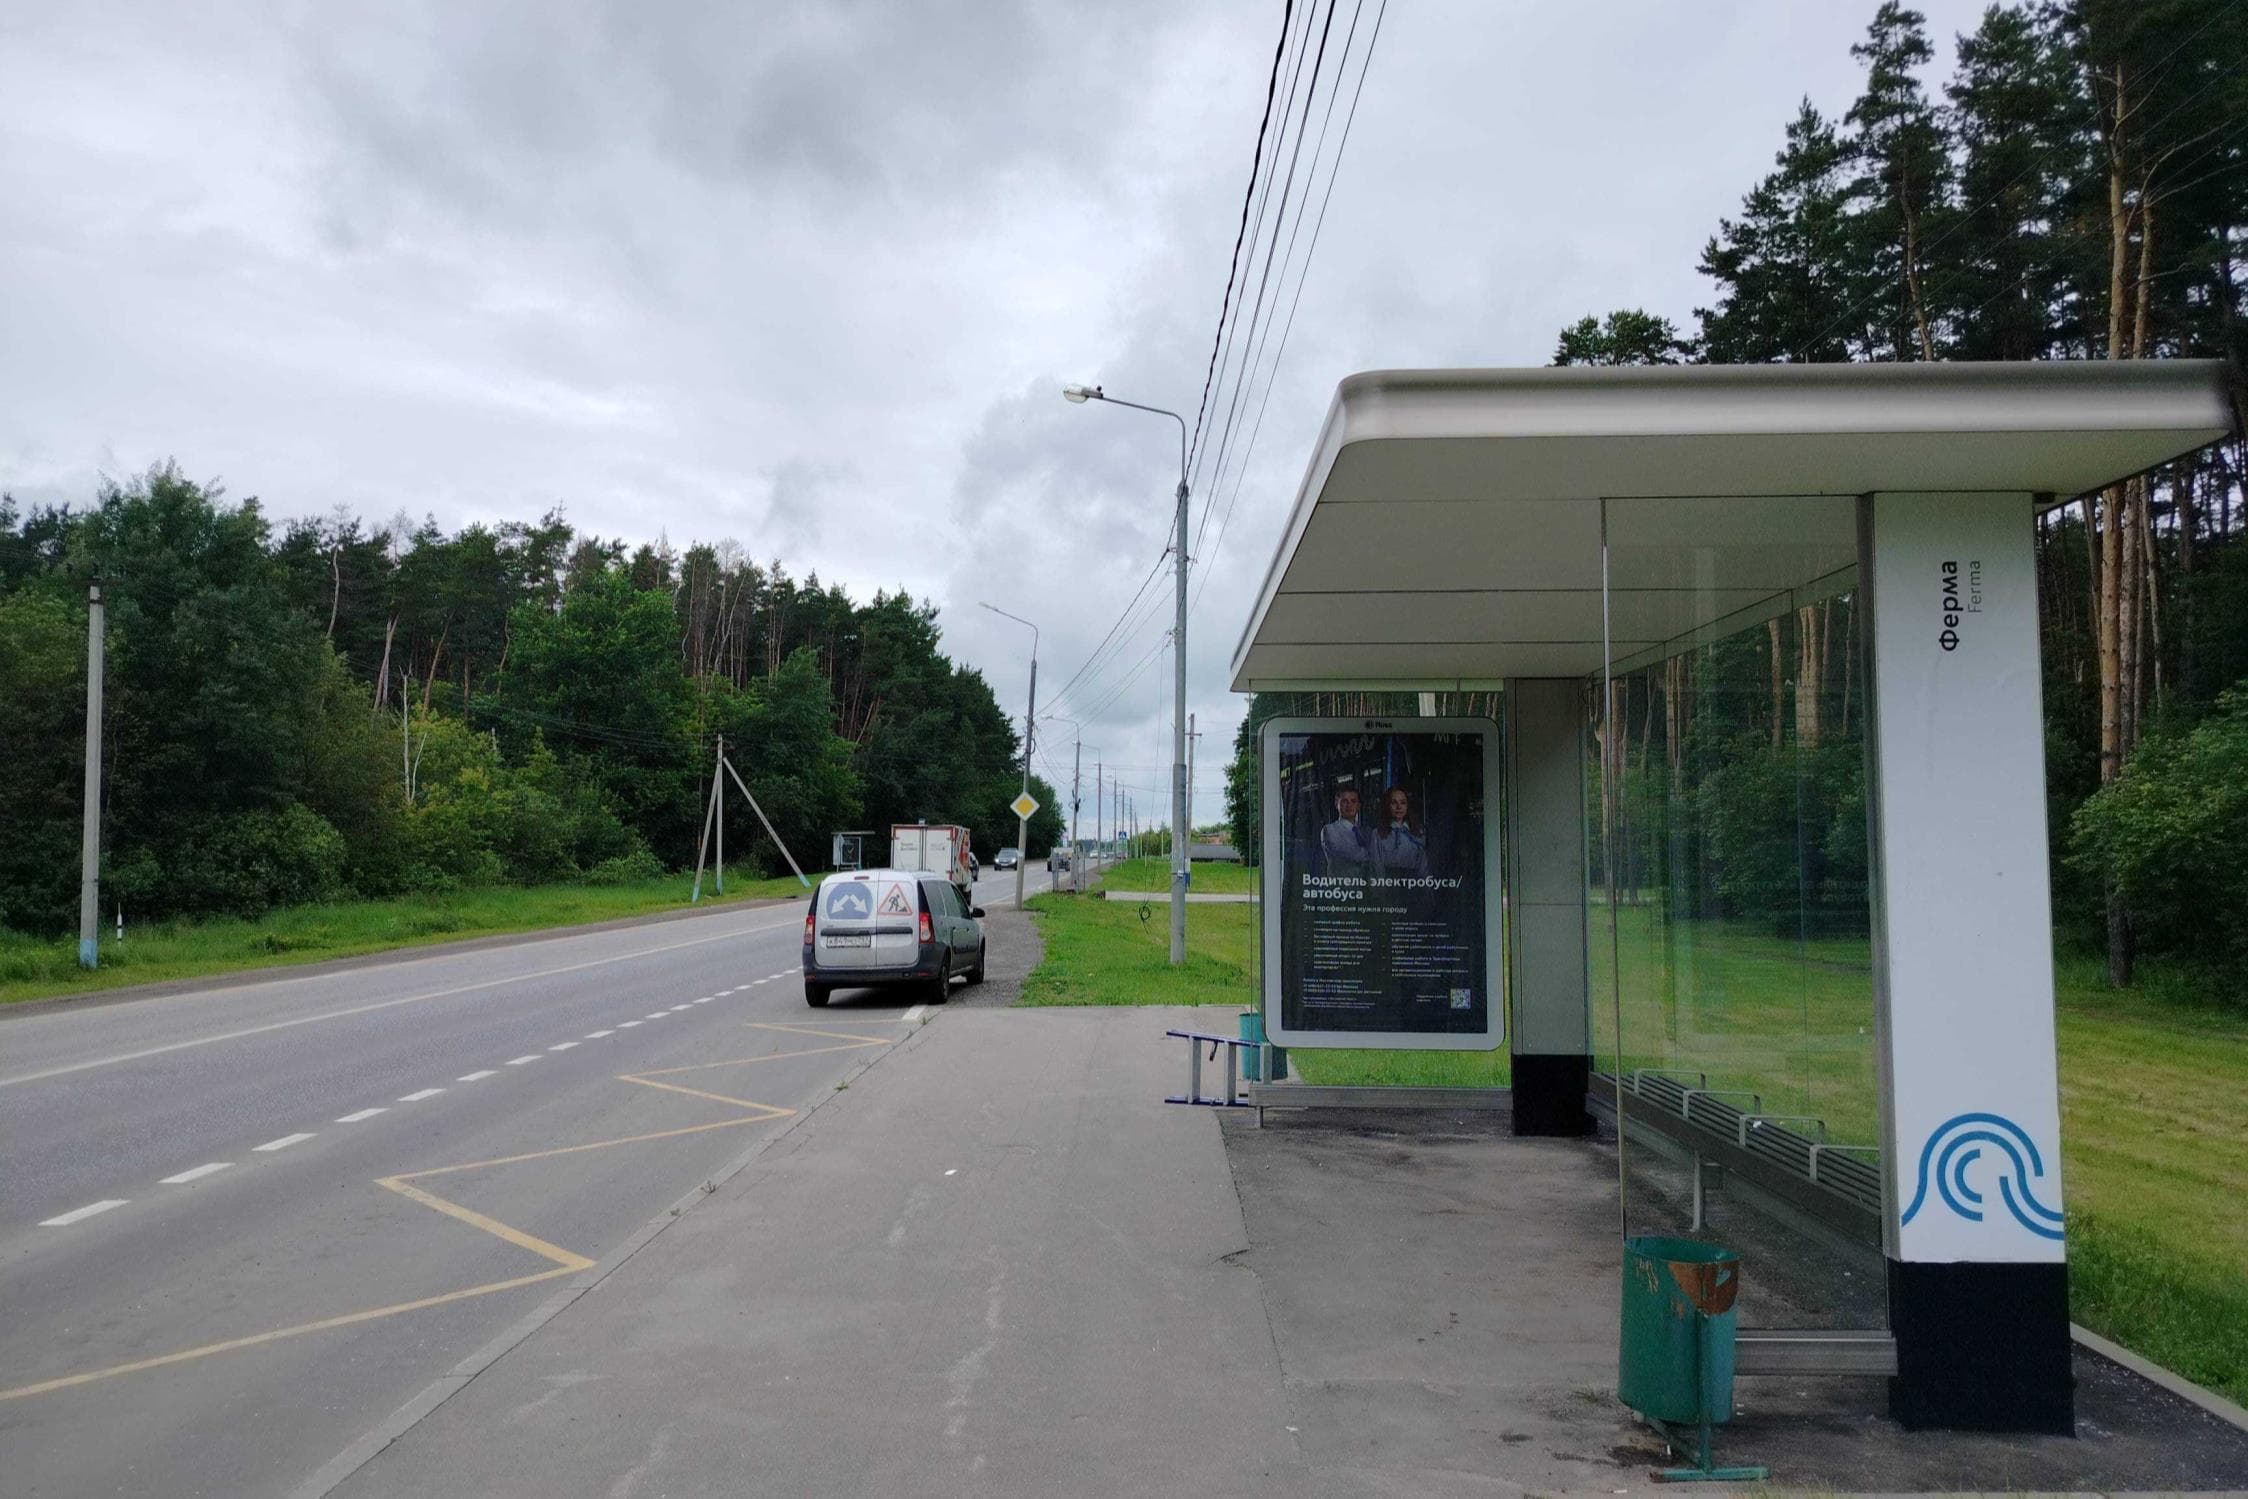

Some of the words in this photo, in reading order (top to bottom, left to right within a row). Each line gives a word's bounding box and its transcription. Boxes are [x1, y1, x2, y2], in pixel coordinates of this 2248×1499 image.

[1967, 560, 1982, 613] Ferma
[1939, 560, 1963, 652] Ферма
[1302, 873, 1367, 887] Водитель
[1370, 875, 1462, 888] электробуса/
[1302, 887, 1363, 901] автобуса
[1302, 904, 1315, 912] Эта
[1317, 904, 1356, 914] профессия
